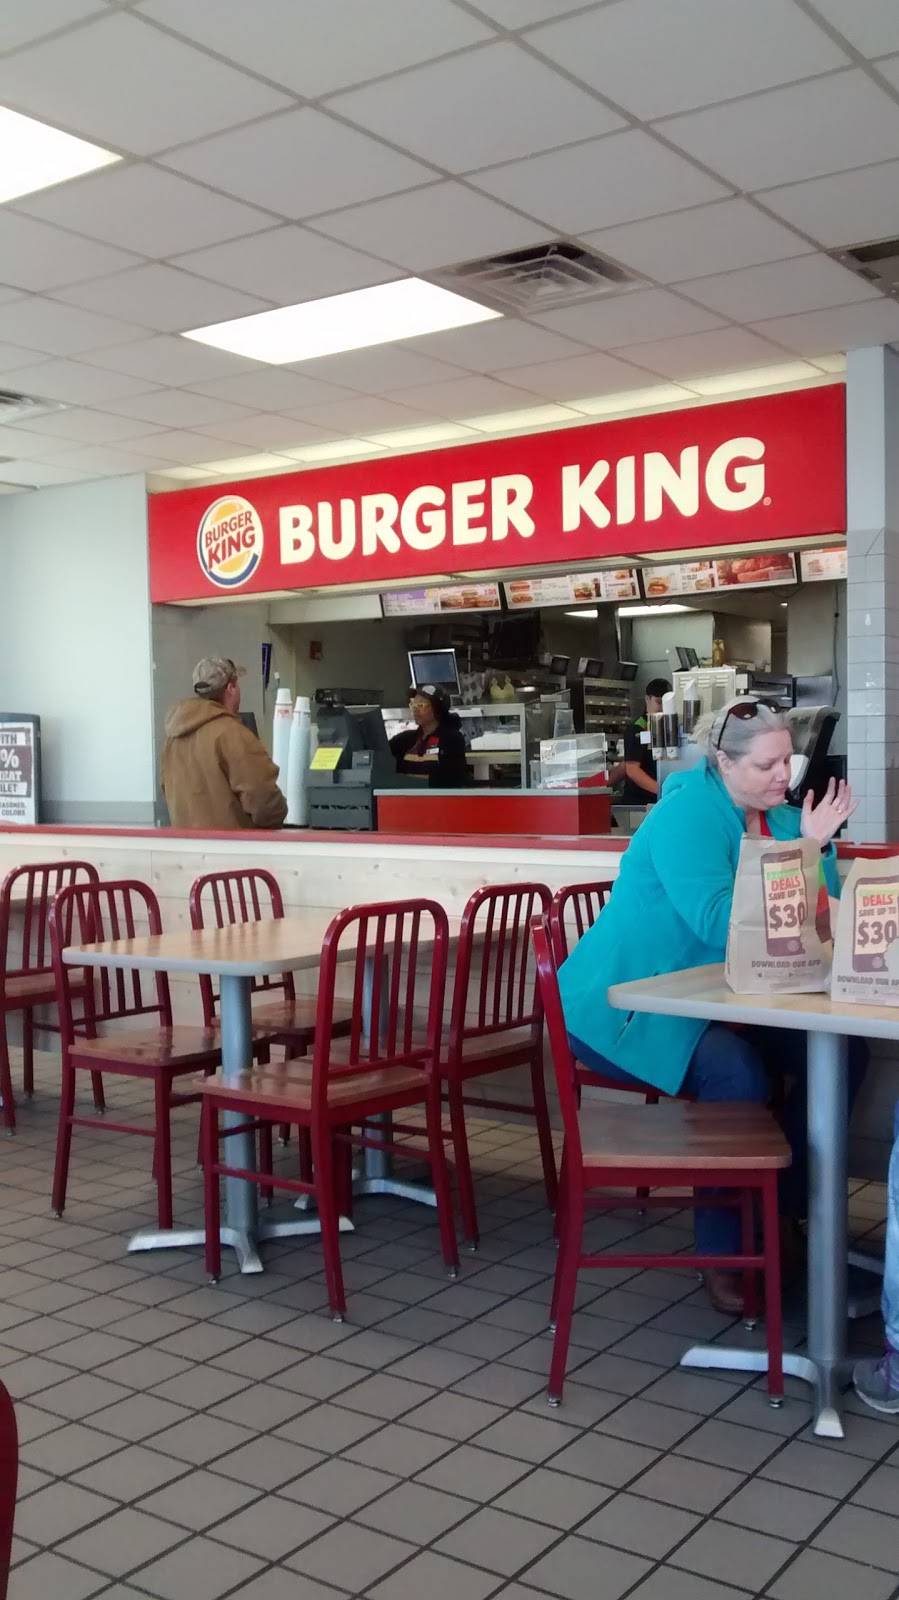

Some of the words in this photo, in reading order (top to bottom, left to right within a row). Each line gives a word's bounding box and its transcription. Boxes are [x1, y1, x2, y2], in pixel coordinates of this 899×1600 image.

[279, 473, 535, 565] BURGER
[562, 436, 766, 533] KING
[204, 510, 253, 547] BURGER
[207, 526, 257, 571] KING
[0, 770, 22, 781] EAT
[771, 876, 801, 891] DEALS
[768, 891, 786, 901] SAVE
[788, 889, 797, 898] UP
[862, 894, 894, 907] DEALS
[768, 902, 805, 932] $30
[858, 908, 875, 917] SAVE
[877, 907, 886, 916] UP
[888, 906, 897, 915] TO
[857, 919, 898, 948] $30
[751, 960, 791, 969] DOWNLOAD
[792, 960, 806, 968] OUR
[807, 959, 822, 967] APP
[837, 975, 874, 985] DOWNLOAD
[875, 976, 889, 986] OUR
